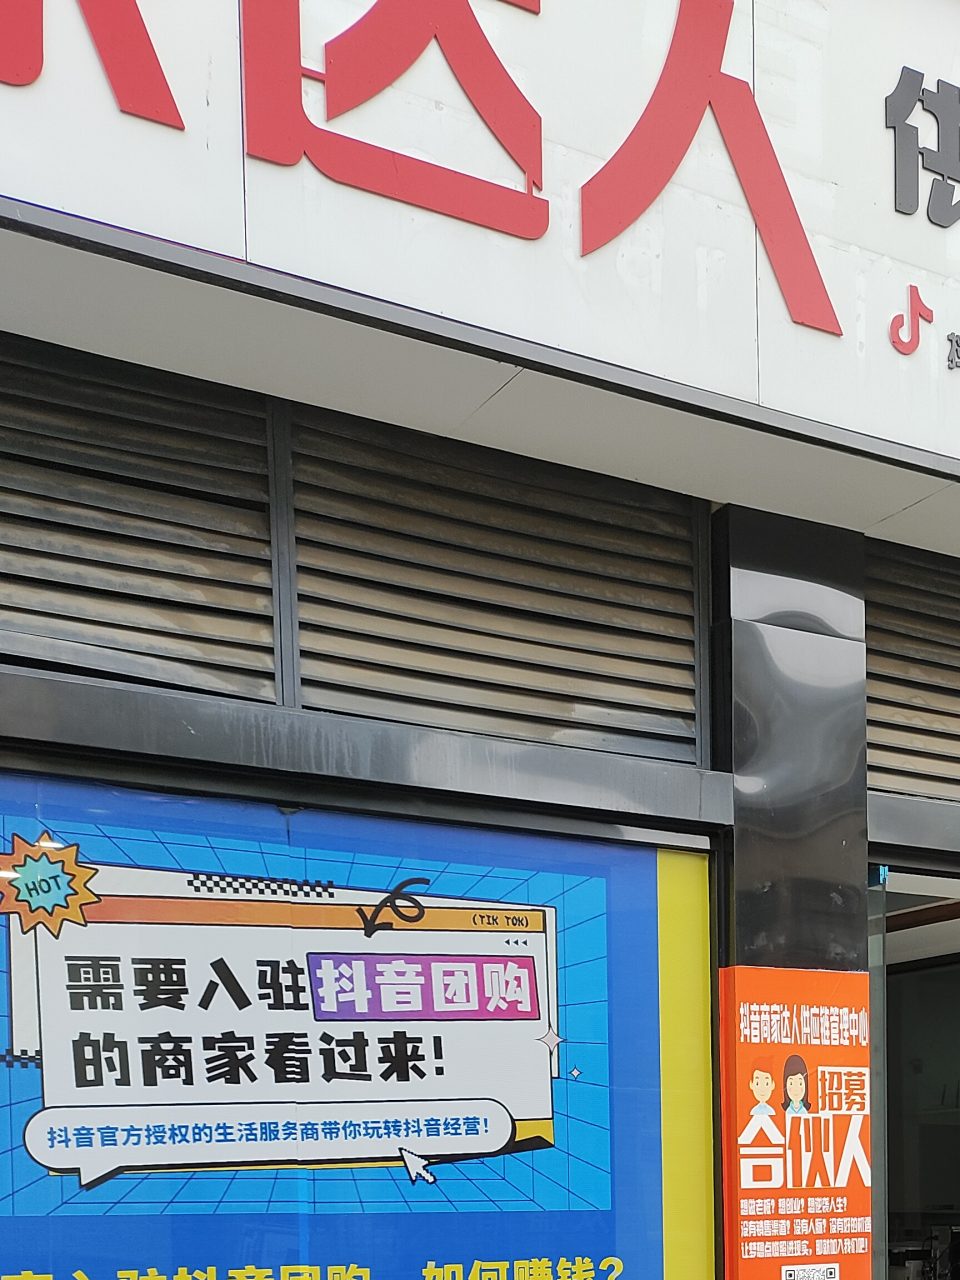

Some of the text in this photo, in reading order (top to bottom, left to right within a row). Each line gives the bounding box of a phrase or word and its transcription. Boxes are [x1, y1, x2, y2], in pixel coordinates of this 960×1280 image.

[0, 0, 843, 337] 达人
[24, 875, 62, 898] HOT
[64, 954, 533, 1015] 需要入驻抖音团购
[740, 1002, 868, 1046] 抖音商家达人供应链管理中心
[72, 1030, 445, 1089] 的商家看过来!
[819, 1070, 867, 1112] 招募
[737, 1114, 871, 1189] 合伙人
